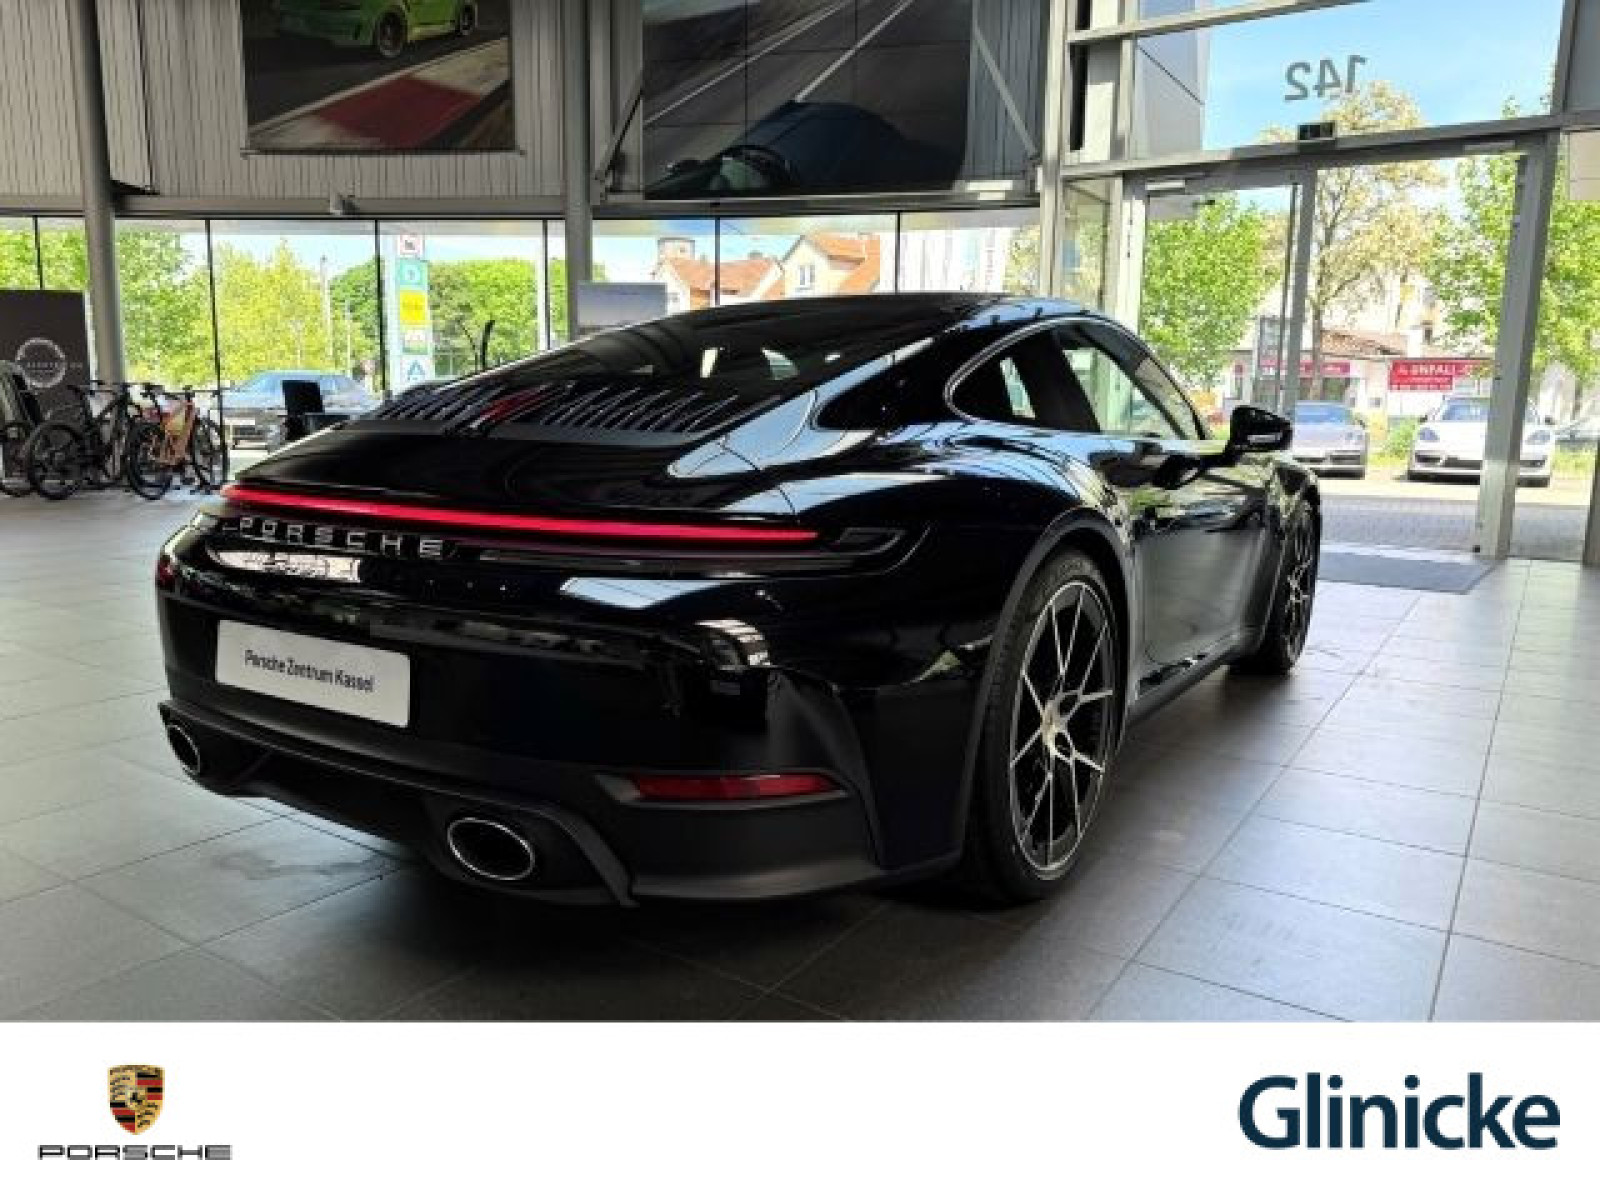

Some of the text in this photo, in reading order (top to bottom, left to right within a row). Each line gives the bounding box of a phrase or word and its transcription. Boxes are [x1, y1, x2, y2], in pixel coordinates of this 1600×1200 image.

[239, 517, 443, 560] PORSCHE
[244, 650, 375, 693] Porsche Zentrum Kassel
